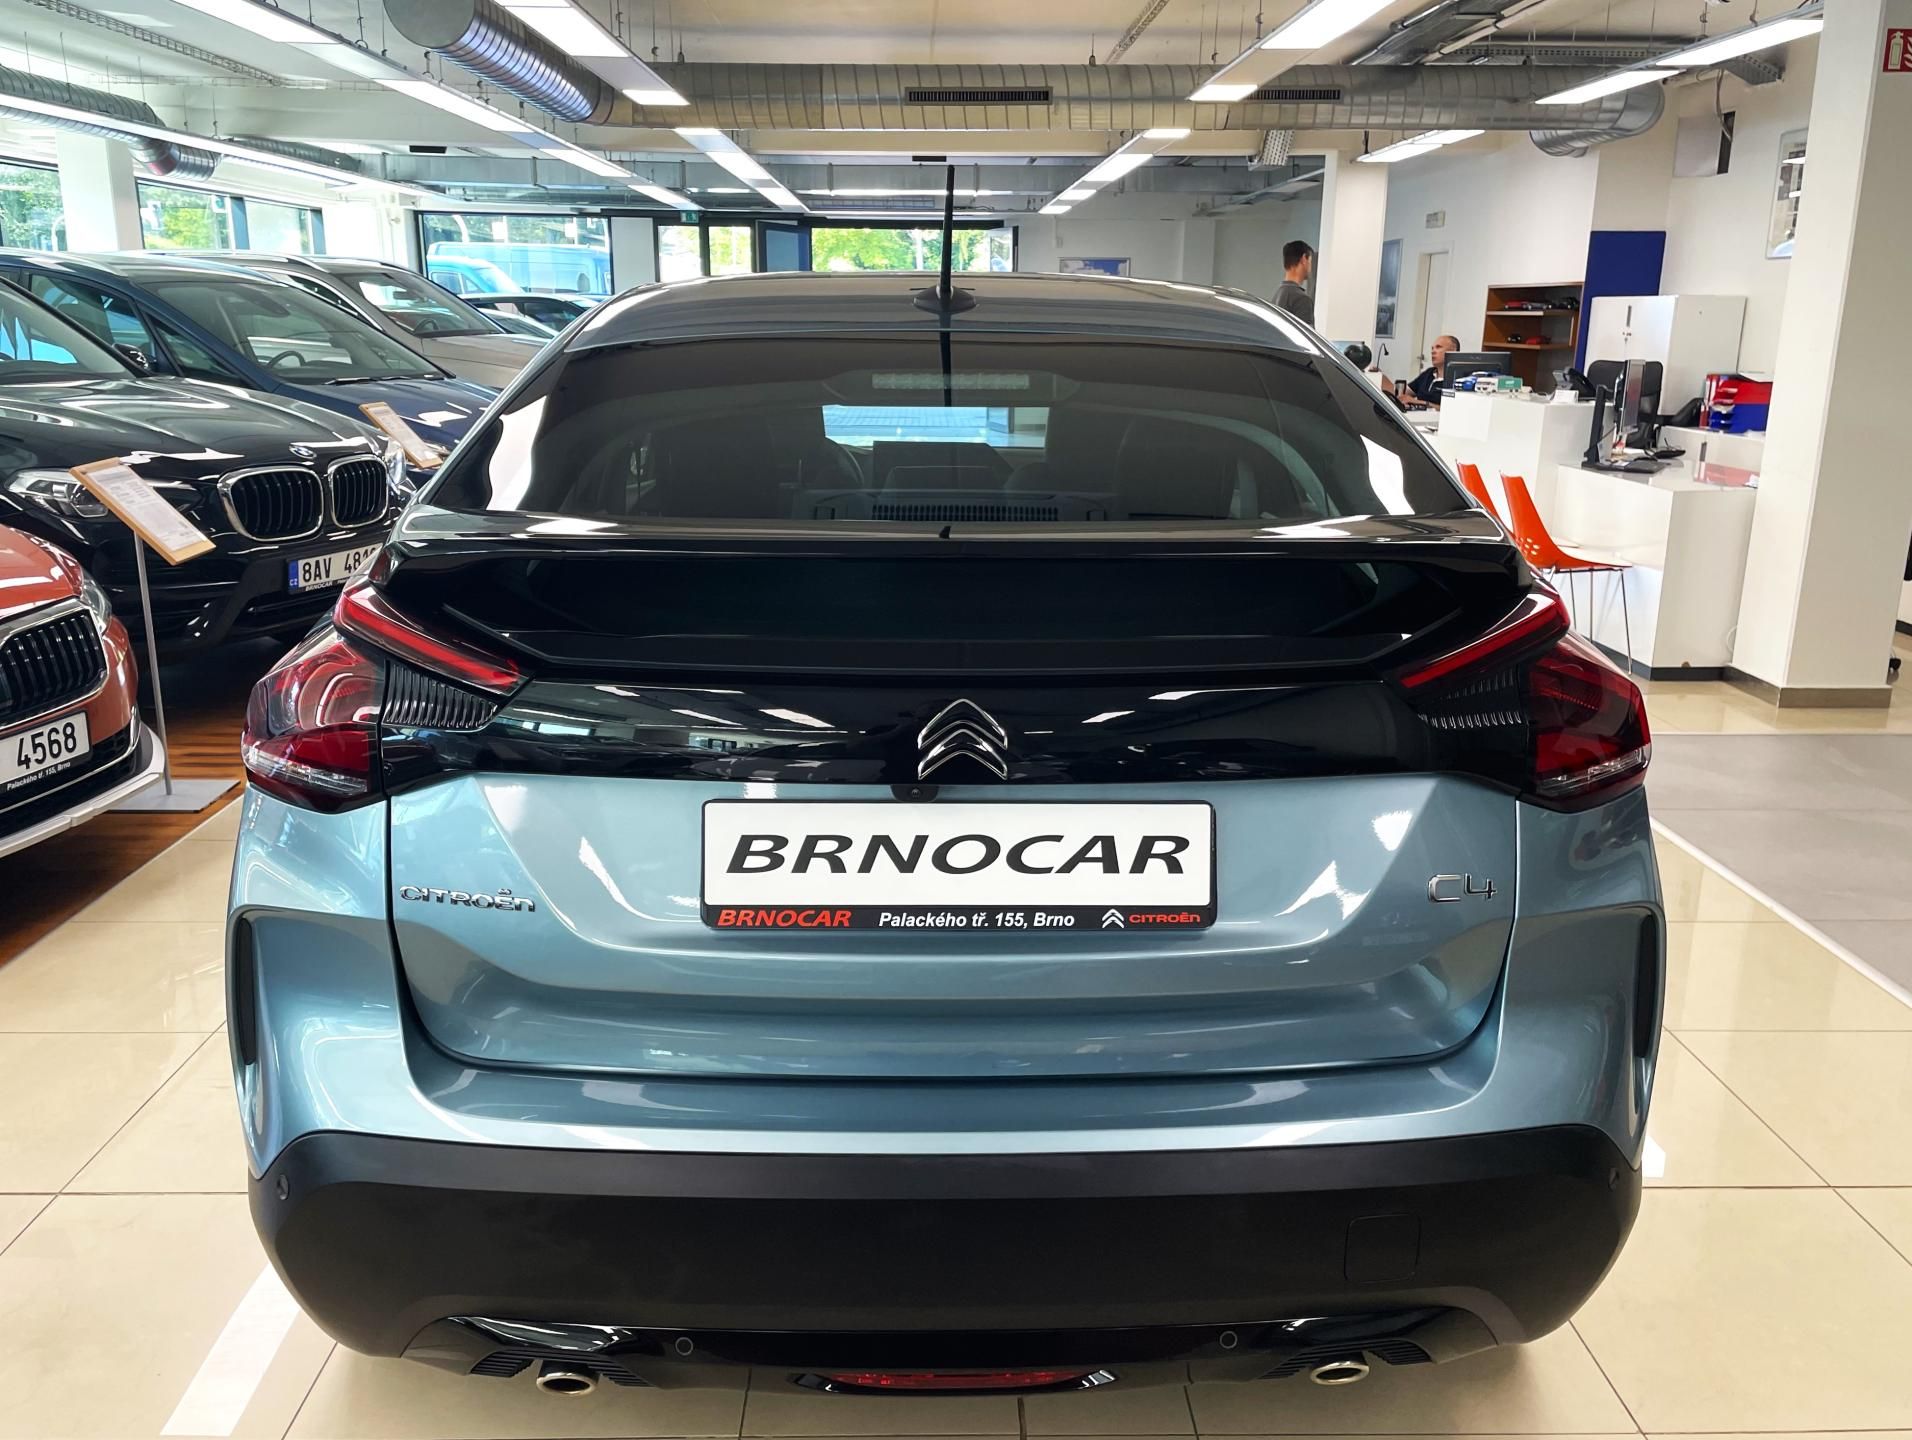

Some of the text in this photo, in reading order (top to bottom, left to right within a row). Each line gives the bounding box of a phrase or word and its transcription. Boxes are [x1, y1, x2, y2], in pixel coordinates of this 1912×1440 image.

[302, 557, 332, 582] 8AV
[17, 722, 77, 769] 4568
[726, 834, 1190, 874] BRNOCAR
[1427, 872, 1498, 904] C4
[717, 909, 1075, 928] BRNOCAR Palackého tř. 155, Brno
